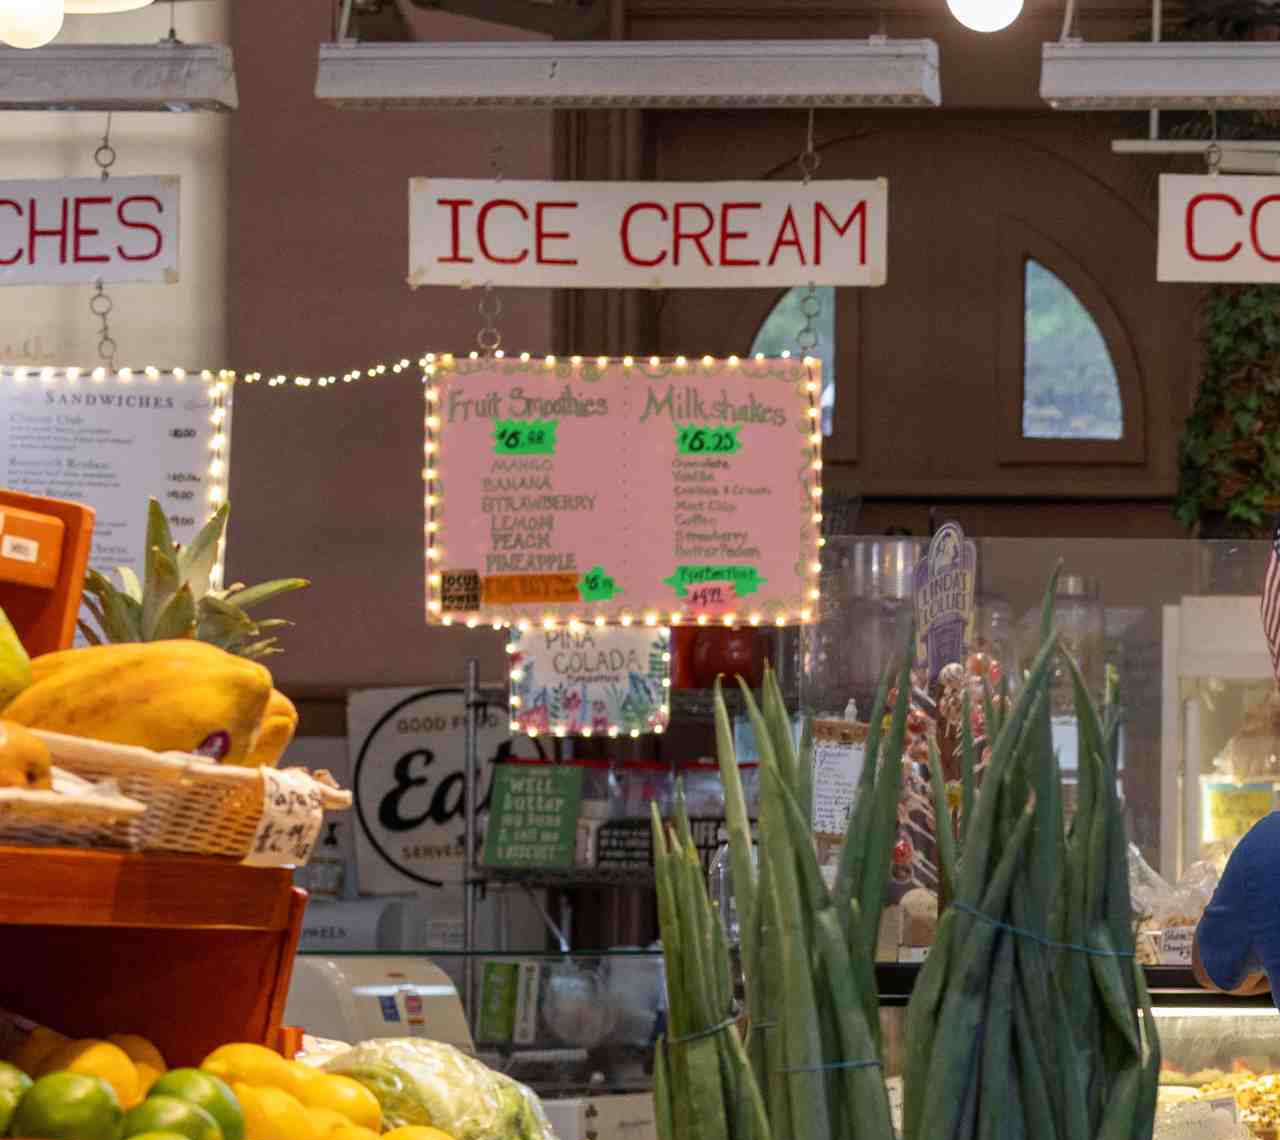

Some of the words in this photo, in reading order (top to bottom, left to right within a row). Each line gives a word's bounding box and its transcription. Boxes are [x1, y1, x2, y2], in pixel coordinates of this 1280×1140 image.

[436, 197, 579, 267] ICE
[618, 199, 869, 268] CREAM
[45, 392, 174, 410] SANDWICHES
[448, 389, 501, 423] Fruit
[509, 386, 609, 417] Smoothies
[481, 476, 552, 490] BANANA
[481, 495, 596, 513] STRAWBERRY
[486, 553, 577, 571] PINEAPPLE
[920, 570, 968, 605] LINDA'S
[552, 649, 643, 674] COLADA
[398, 715, 447, 735] GOOD
